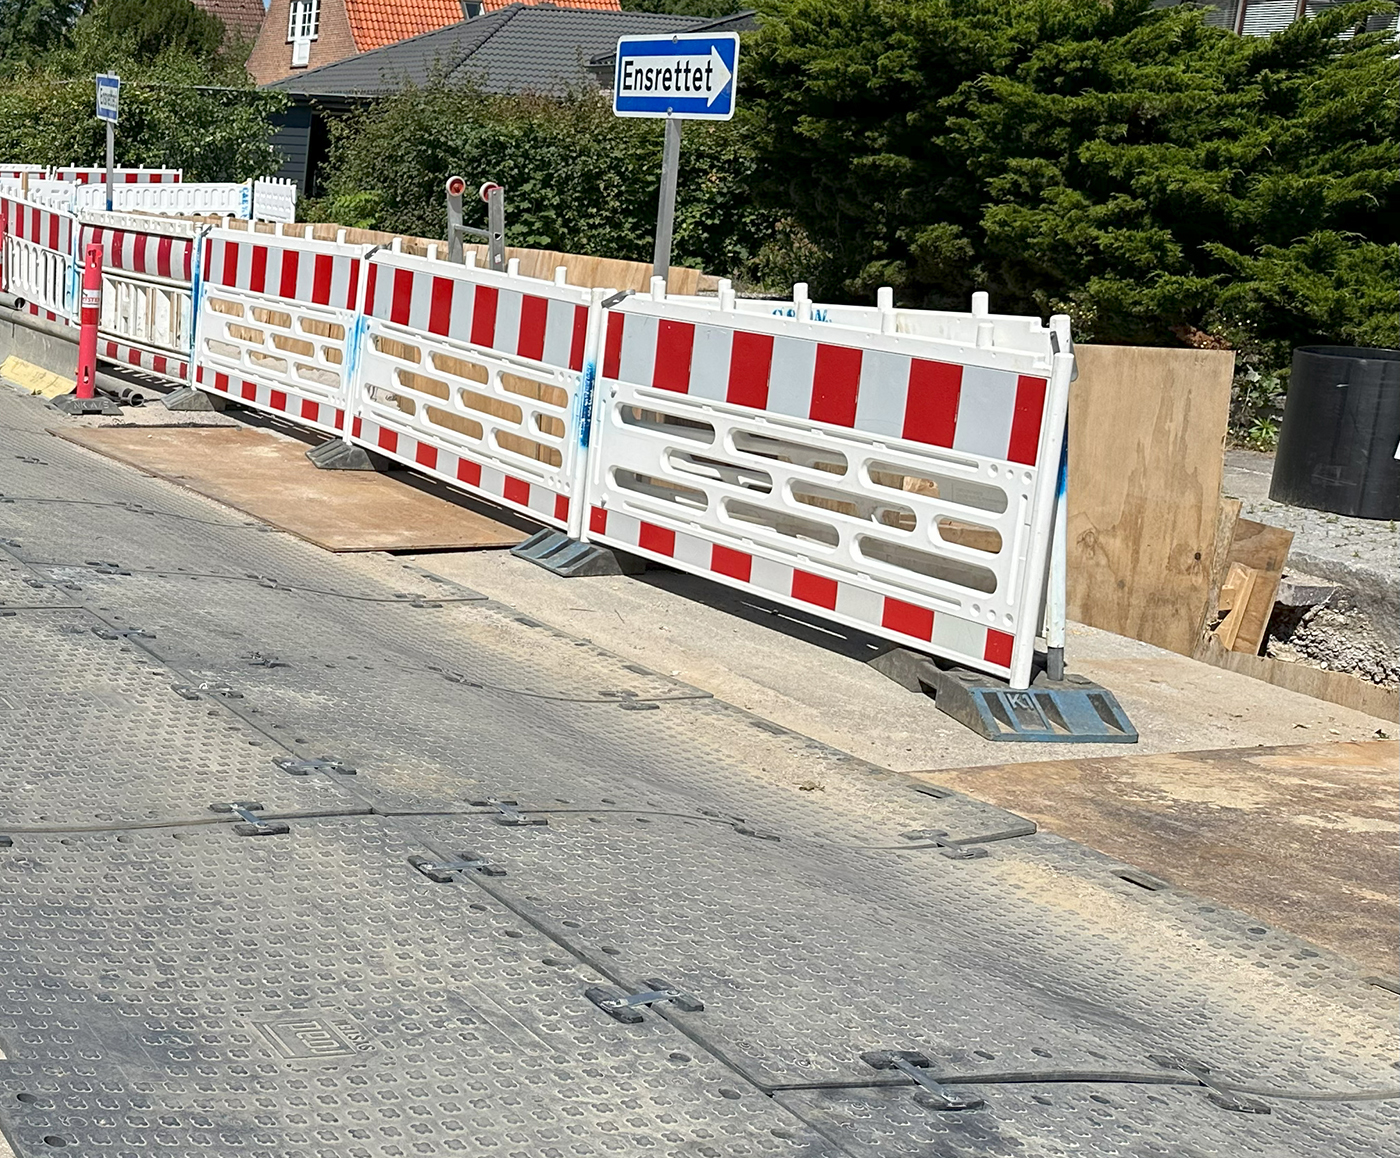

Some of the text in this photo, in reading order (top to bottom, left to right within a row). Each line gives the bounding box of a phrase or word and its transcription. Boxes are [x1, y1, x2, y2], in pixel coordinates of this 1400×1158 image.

[623, 60, 713, 92] Ensrettet
[1006, 693, 1035, 710] K1
[330, 1019, 376, 1051] SYSTEM
